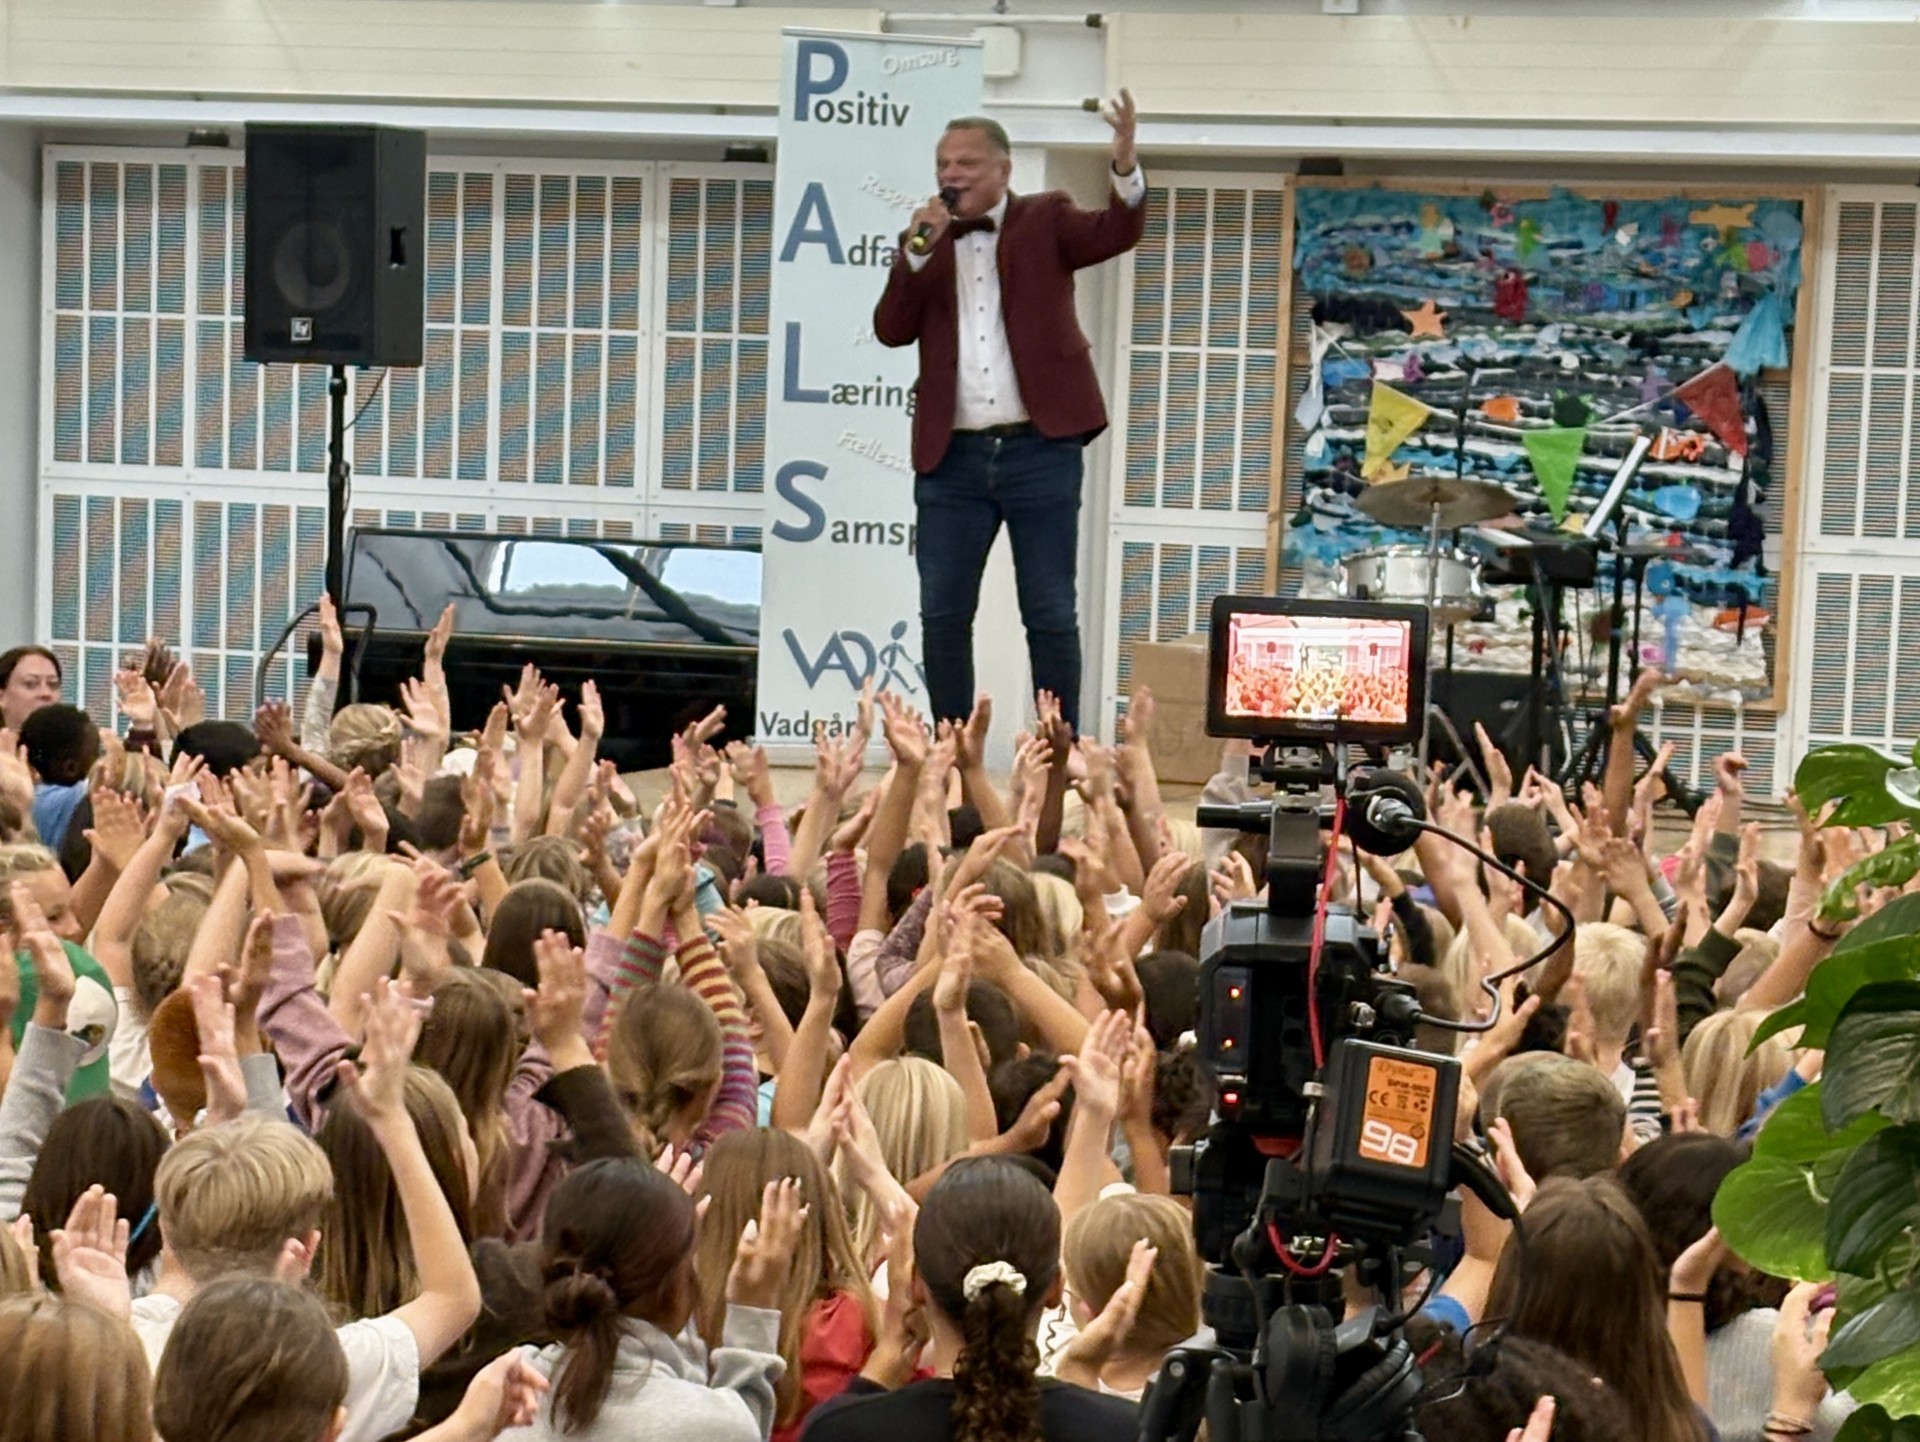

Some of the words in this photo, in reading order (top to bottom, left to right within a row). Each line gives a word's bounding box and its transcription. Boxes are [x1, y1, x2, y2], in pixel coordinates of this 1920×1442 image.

[793, 39, 909, 127] Positiv
[779, 181, 898, 268] Adfa
[783, 321, 918, 417] Læring
[771, 459, 918, 556] Samsp
[1360, 1119, 1419, 1165] 98
